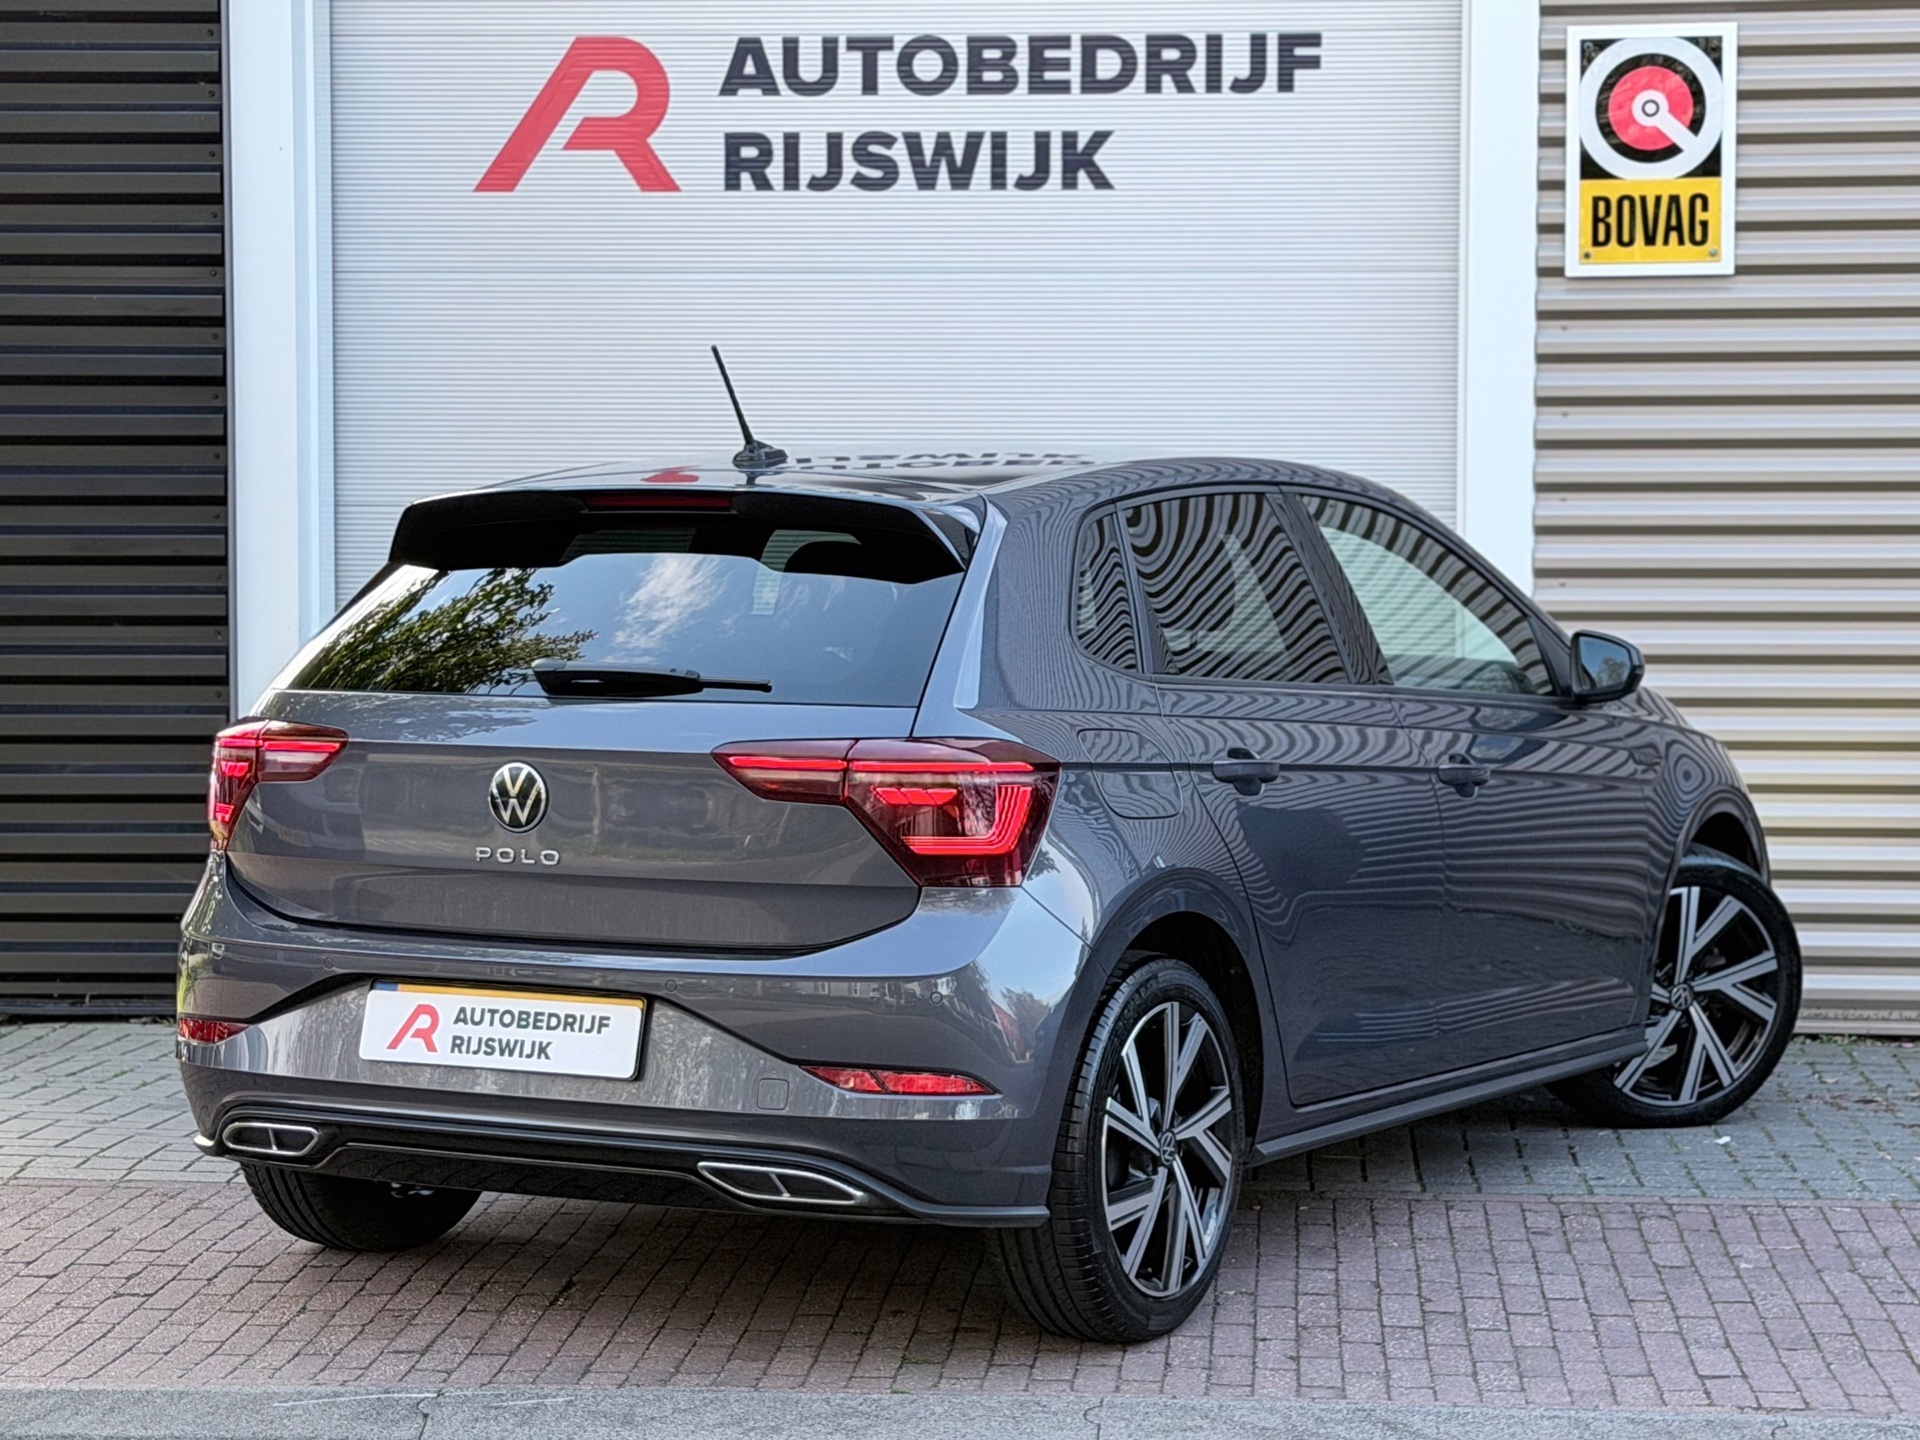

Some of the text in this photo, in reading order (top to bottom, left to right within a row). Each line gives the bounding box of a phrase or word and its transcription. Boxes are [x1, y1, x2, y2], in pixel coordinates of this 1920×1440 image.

[718, 32, 1323, 97] AUTOBEDRIJF
[723, 129, 1115, 193] RIJSWIJK
[1591, 193, 1710, 248] BOVAG
[475, 846, 560, 866] POLO
[453, 1006, 611, 1035] AUTOBEDRIJF
[450, 1035, 553, 1061] RIJSWIJK
